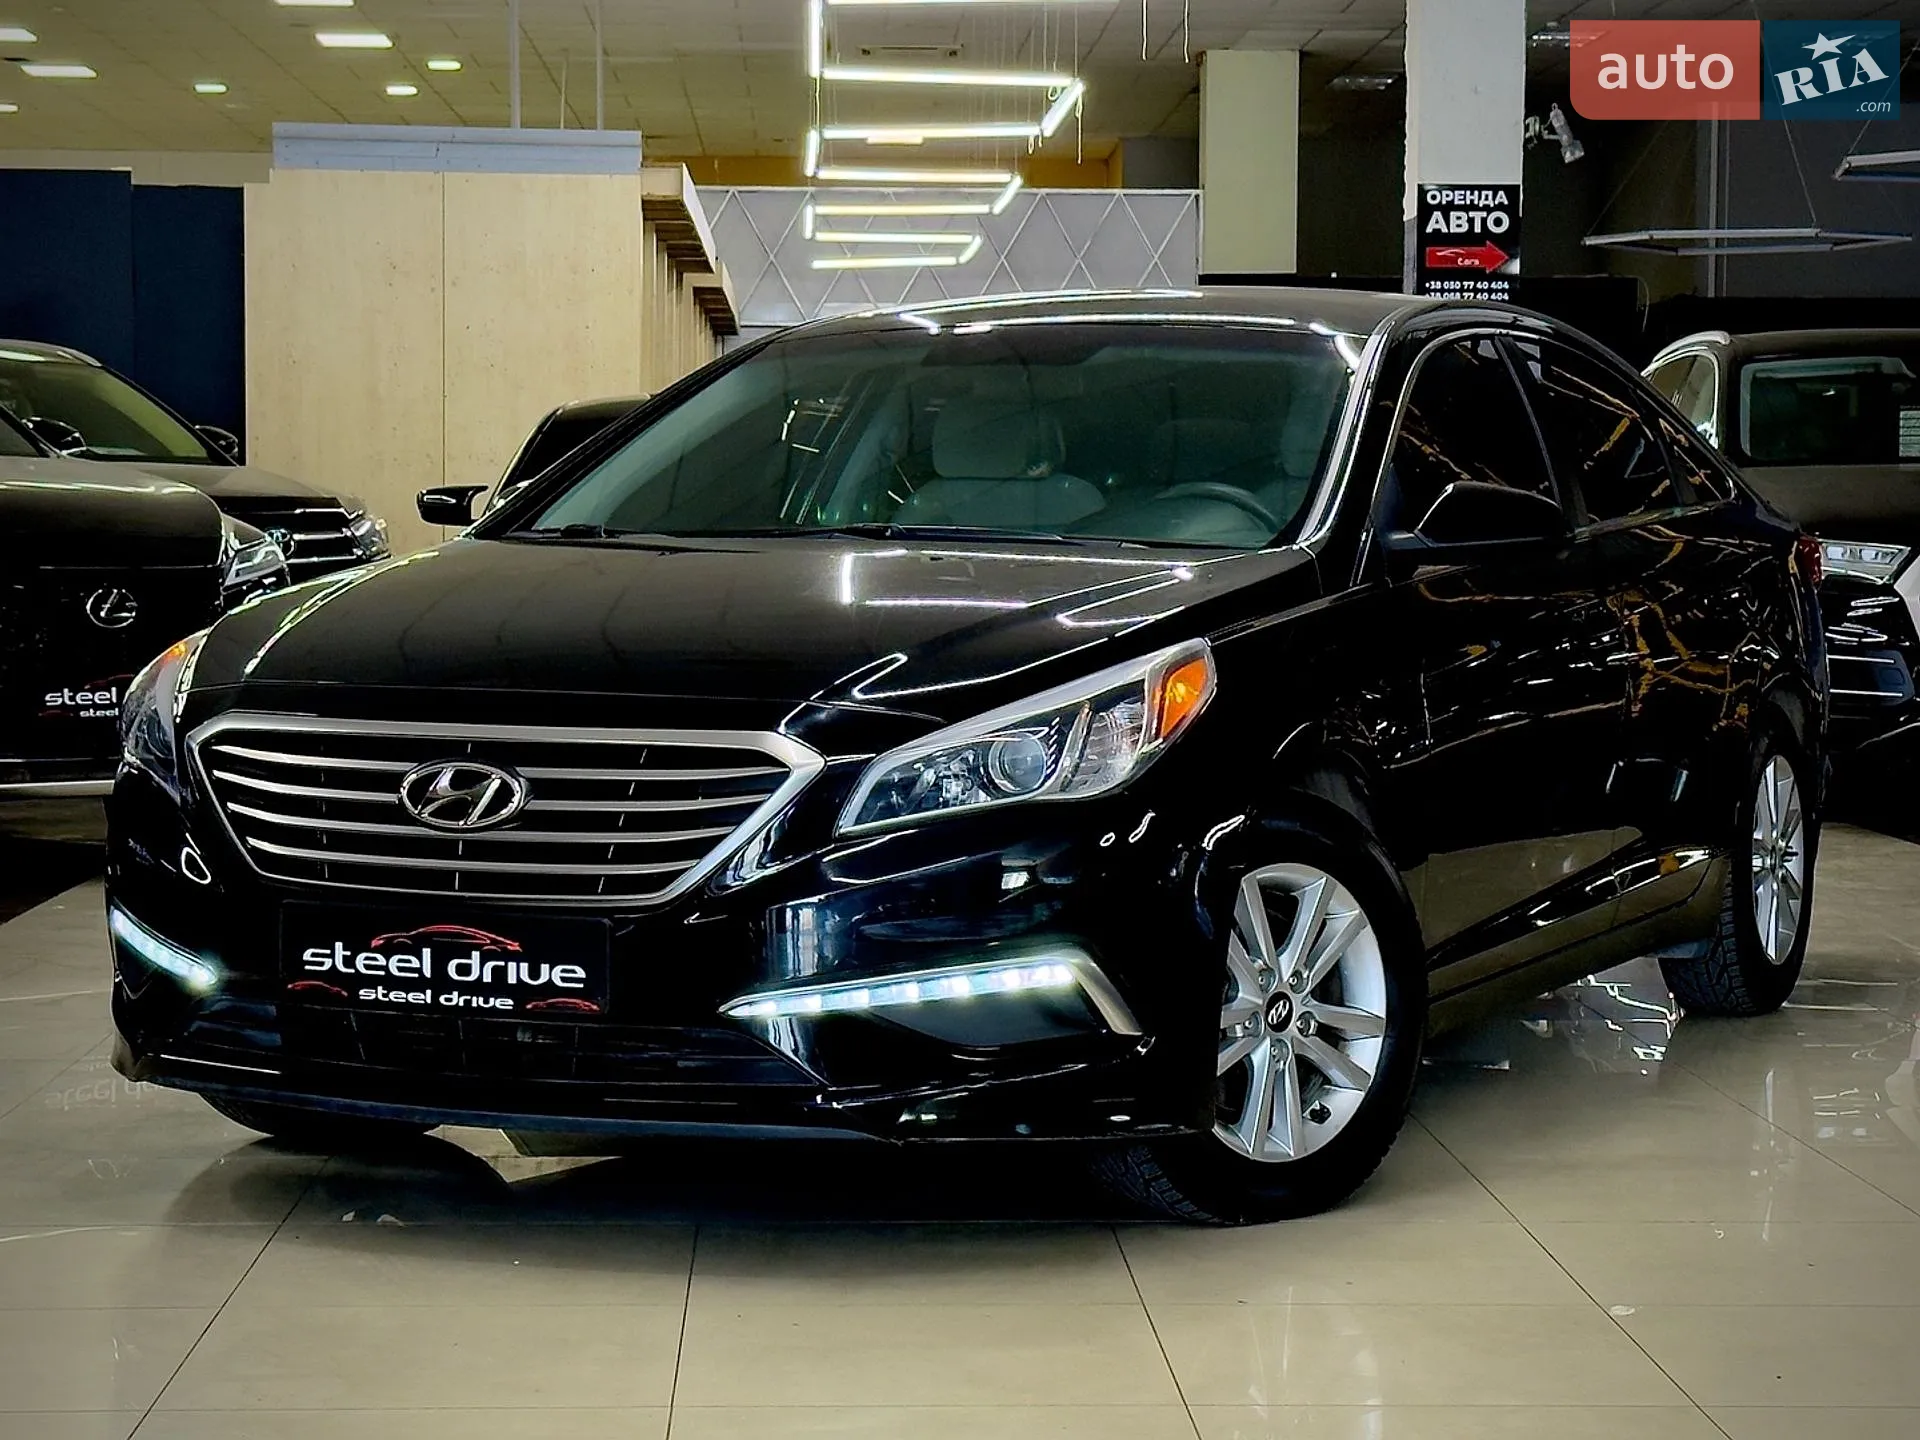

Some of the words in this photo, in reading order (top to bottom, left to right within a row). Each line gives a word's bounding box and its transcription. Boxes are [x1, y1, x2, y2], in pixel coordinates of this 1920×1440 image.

[1426, 190, 1509, 207] ОРЕНДА
[1425, 211, 1510, 233] АВТО
[1457, 257, 1480, 266] Cars
[1462, 281, 1475, 290] 77
[1476, 281, 1489, 290] 40
[1490, 281, 1510, 290] 404
[1462, 292, 1475, 300] 77
[1476, 292, 1489, 301] 40
[1490, 292, 1510, 301] 404
[45, 687, 117, 706] steel
[79, 708, 119, 717] steel
[302, 941, 432, 979] steel
[447, 951, 587, 989] drive
[359, 985, 432, 1004] steel
[439, 991, 514, 1010] drive
